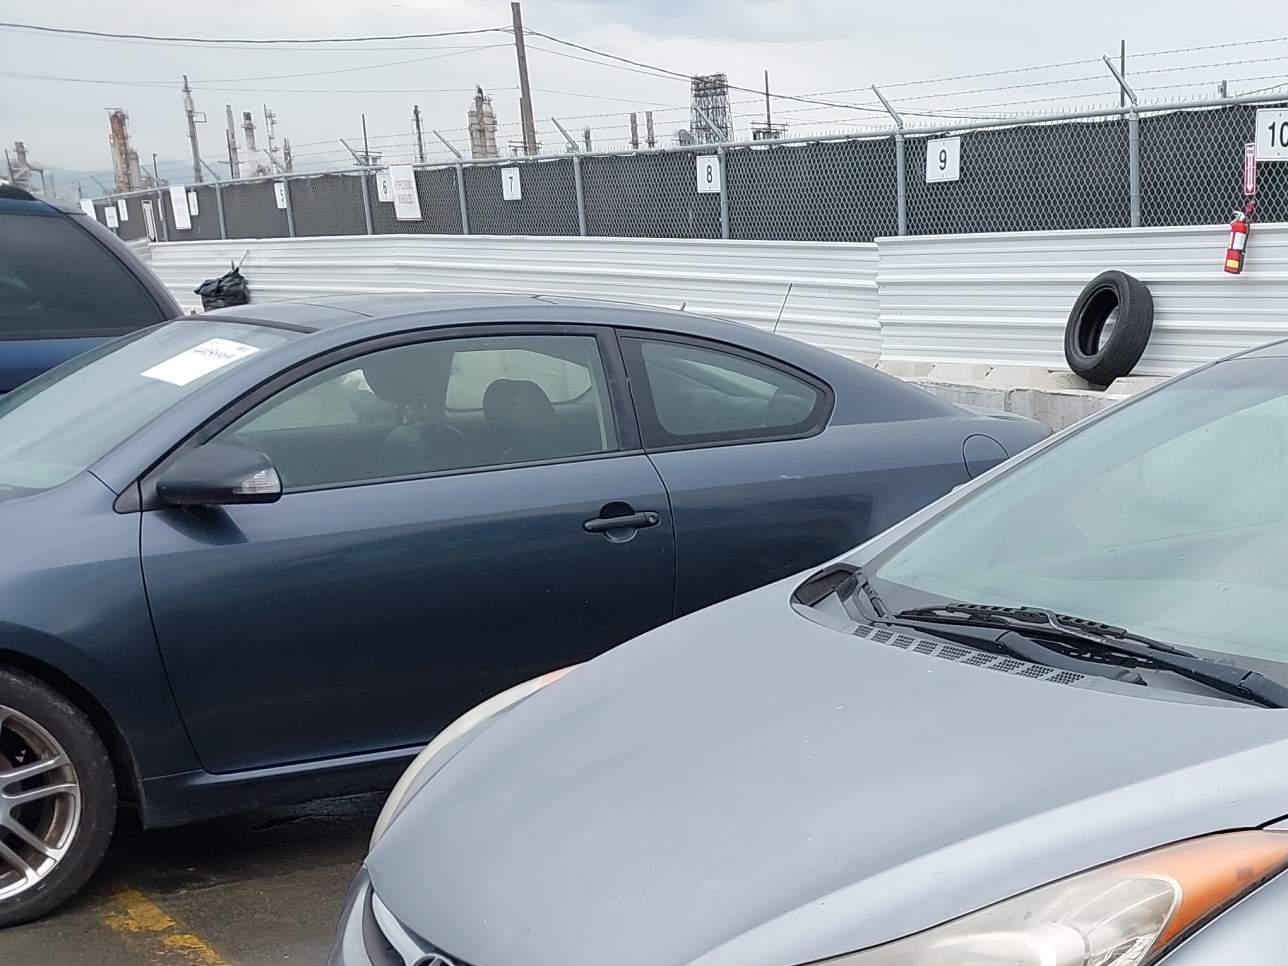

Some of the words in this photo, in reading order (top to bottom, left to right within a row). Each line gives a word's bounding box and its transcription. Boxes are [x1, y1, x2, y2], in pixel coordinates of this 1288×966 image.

[939, 149, 947, 171] 9
[706, 164, 713, 184] 8
[382, 180, 388, 194] 6
[508, 176, 514, 193] 7
